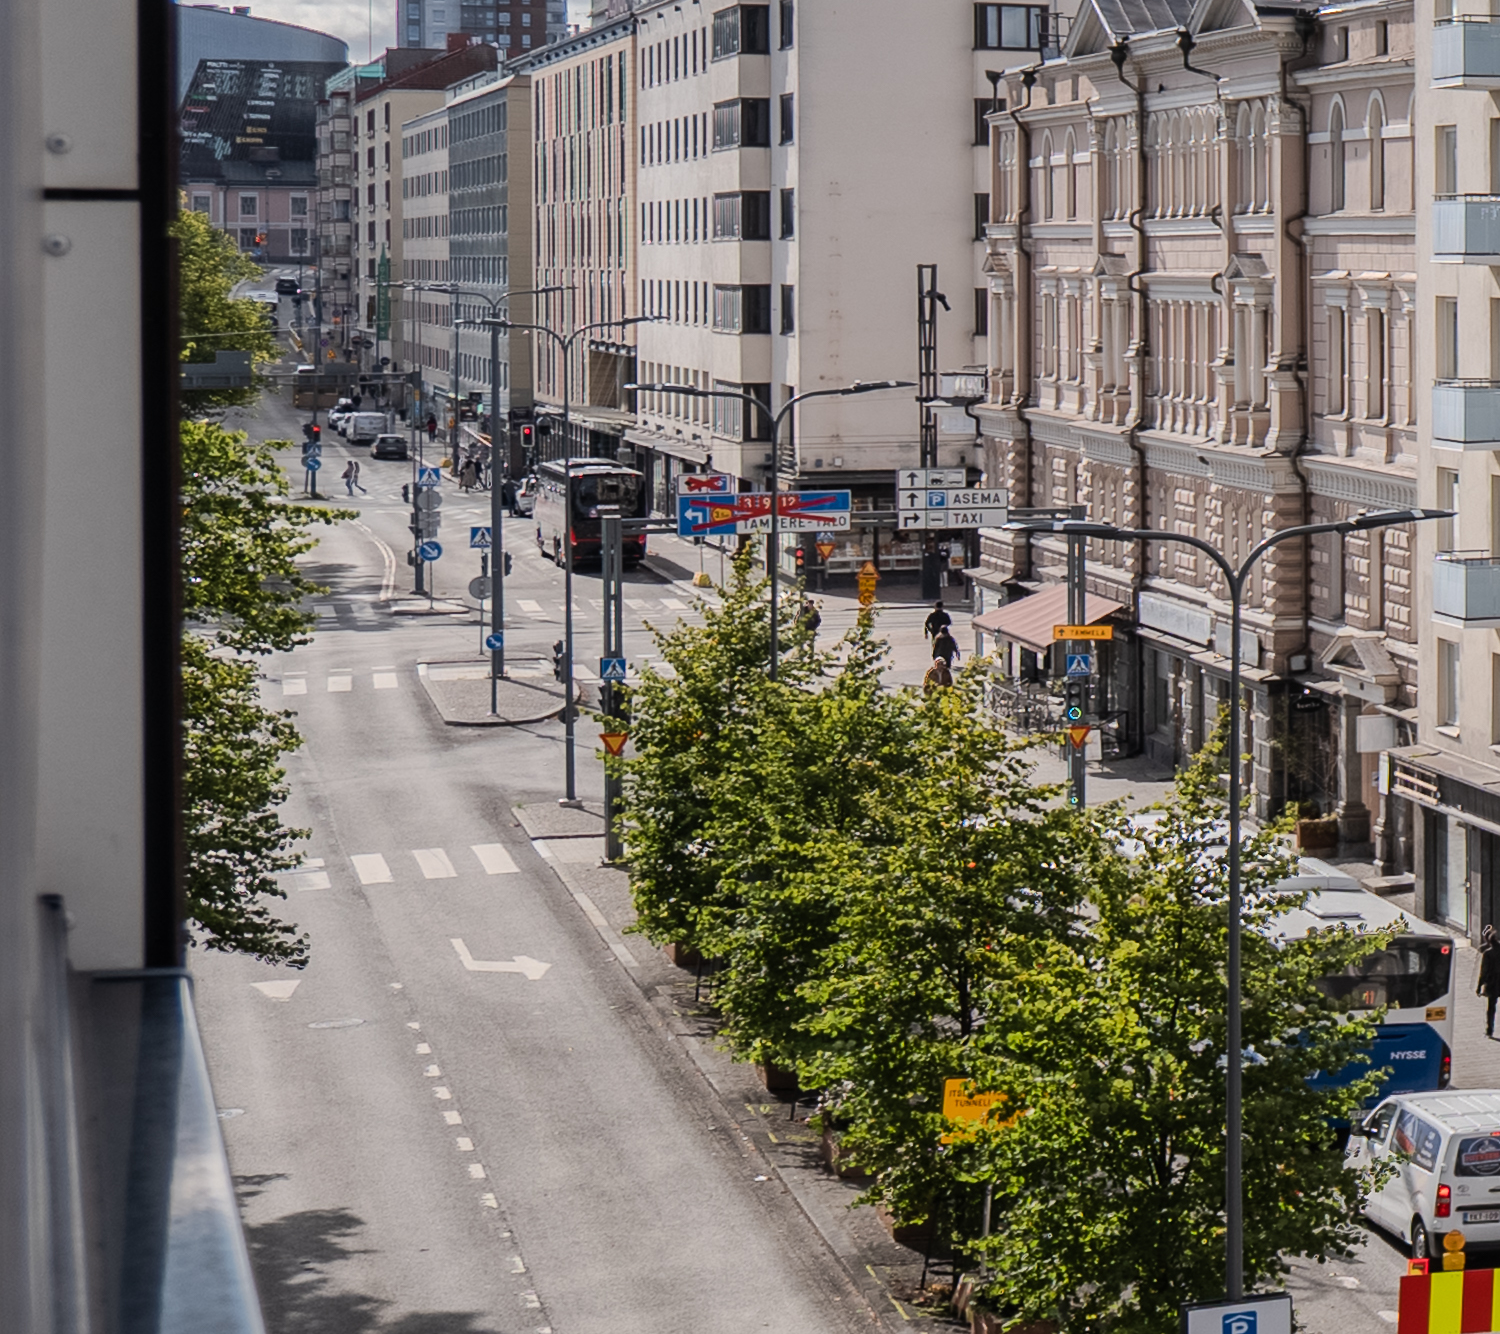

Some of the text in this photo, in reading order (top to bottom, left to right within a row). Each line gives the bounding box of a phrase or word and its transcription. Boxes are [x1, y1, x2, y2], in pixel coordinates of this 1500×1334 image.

[781, 496, 796, 507] 12
[953, 493, 1000, 505] ASEMA
[743, 516, 847, 531] TAMERE-TALO
[953, 513, 983, 525] TAXI
[1390, 1050, 1427, 1060] NYSSE
